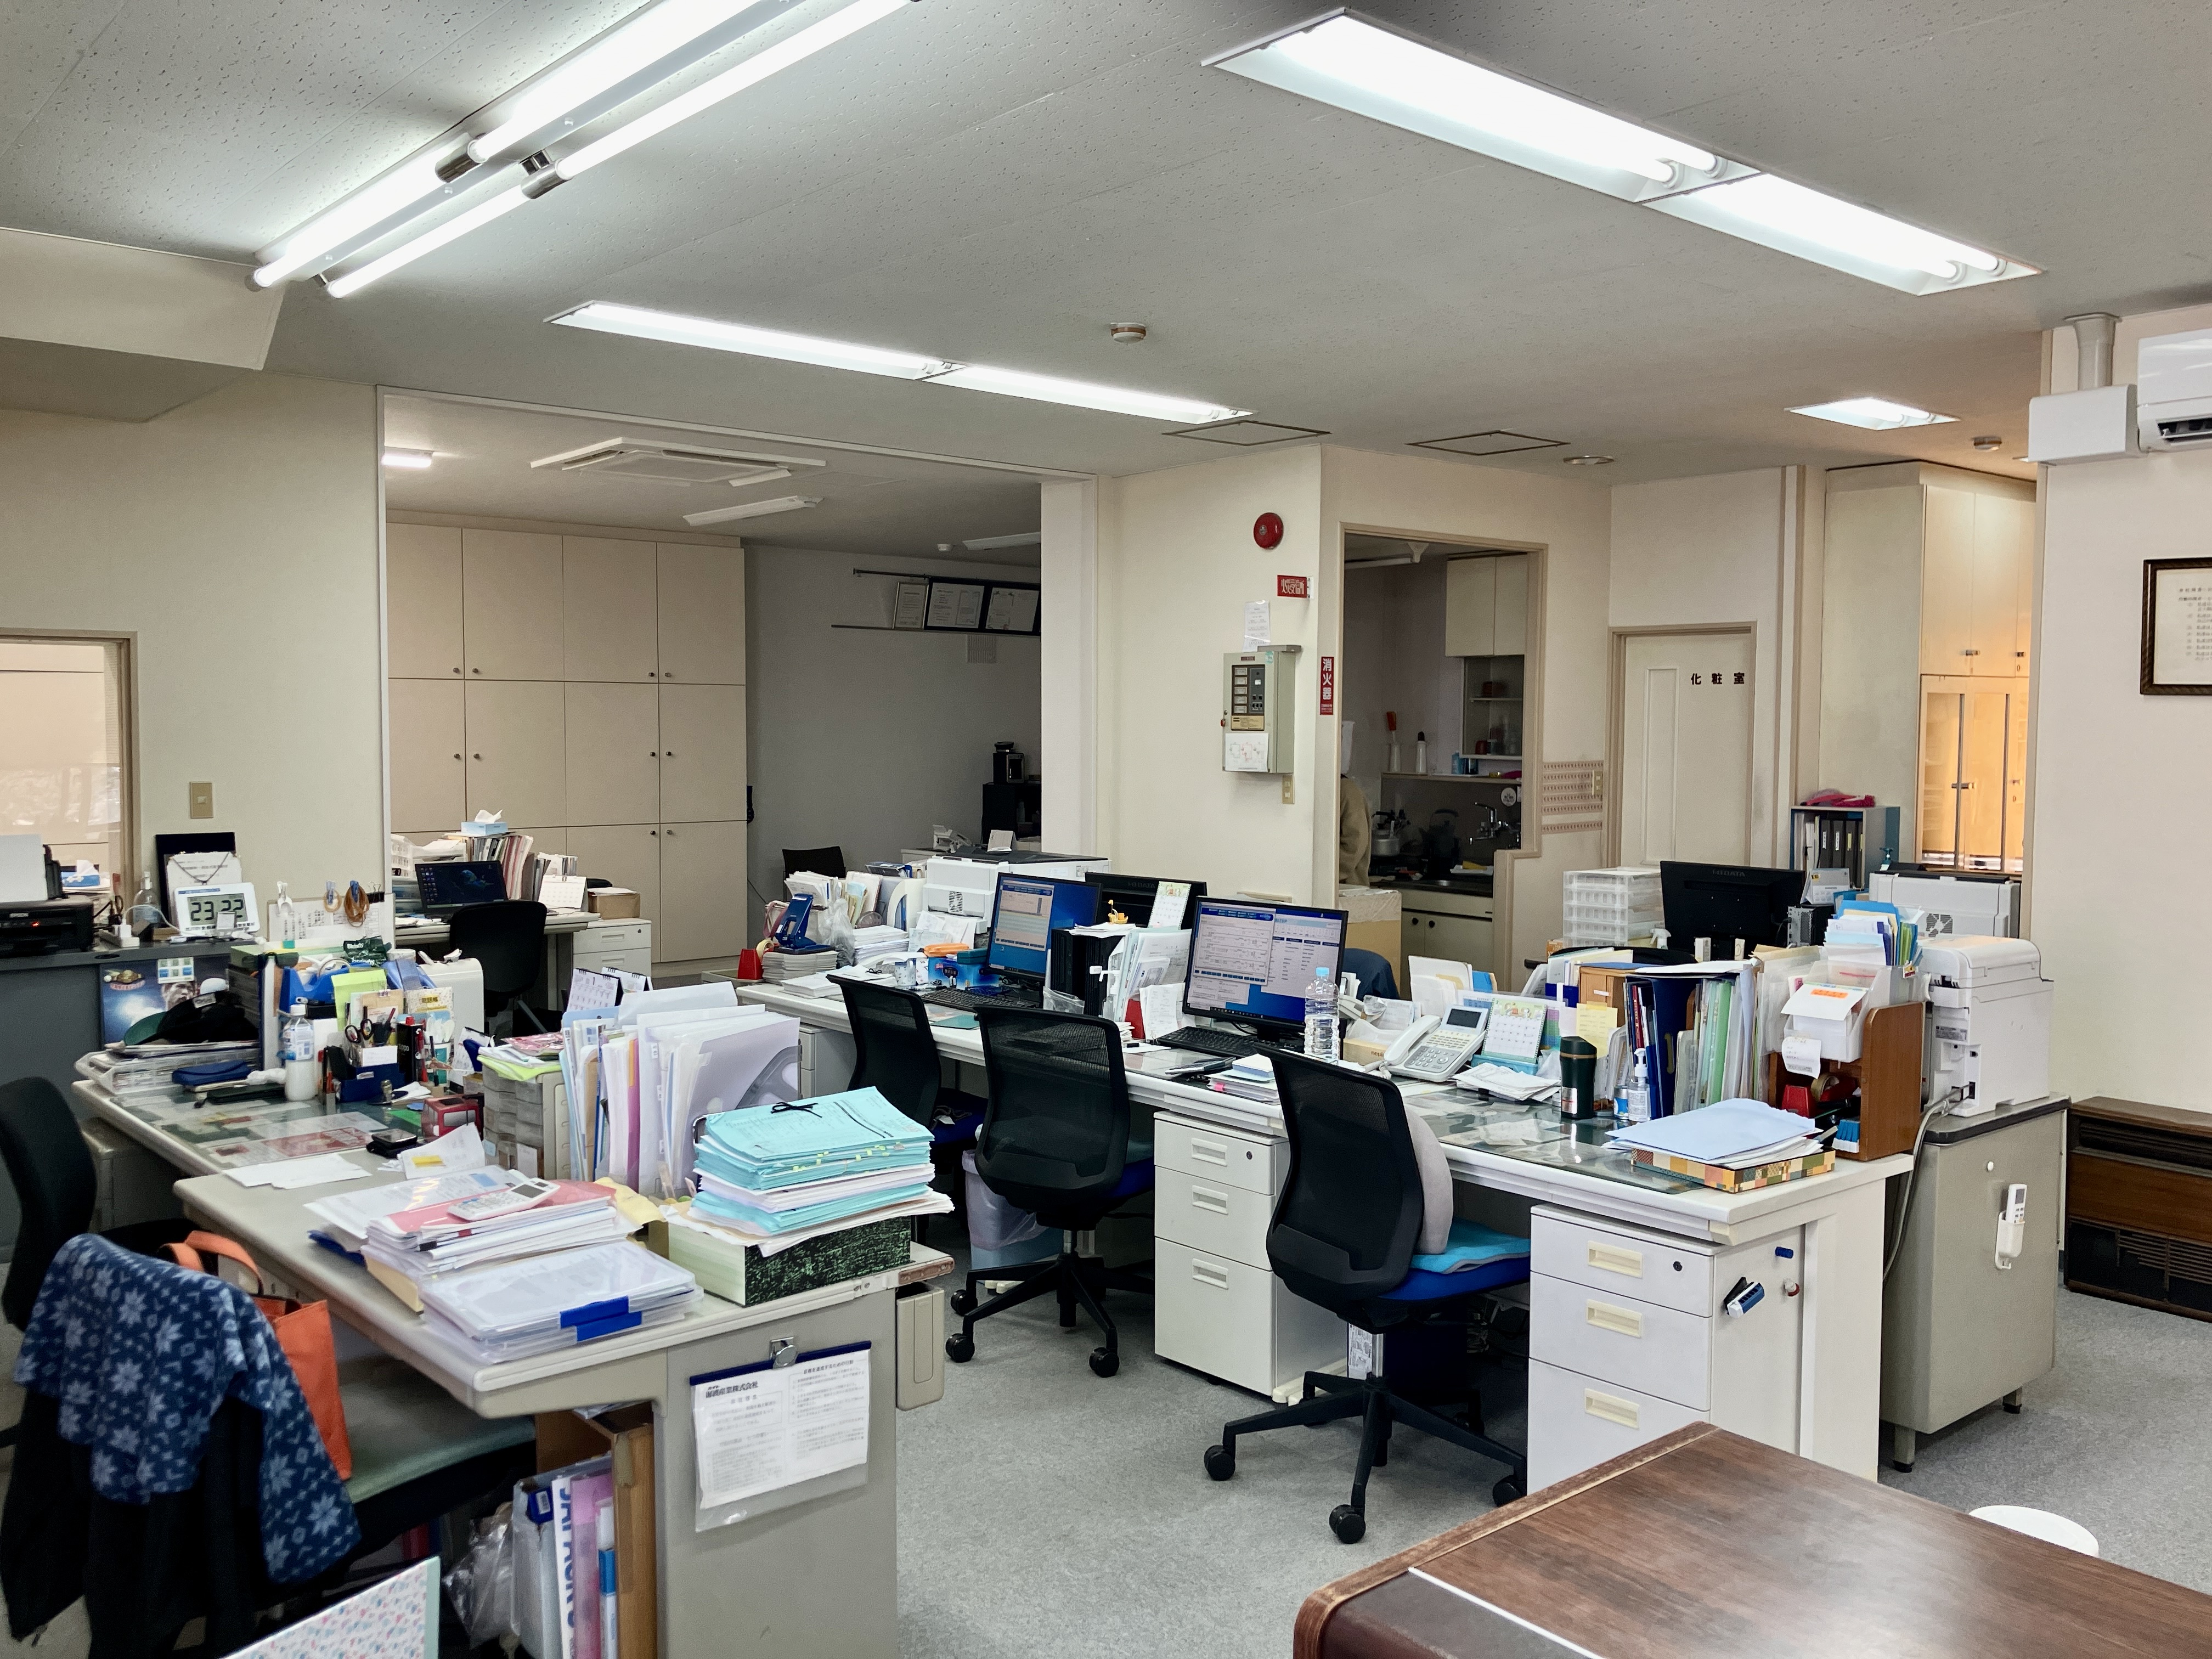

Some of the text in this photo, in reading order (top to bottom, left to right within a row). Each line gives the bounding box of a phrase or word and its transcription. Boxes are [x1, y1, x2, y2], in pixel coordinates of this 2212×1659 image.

[1322, 658, 1332, 700] 消火器
[1690, 672, 1745, 685] 化粧室
[190, 901, 214, 922] 23
